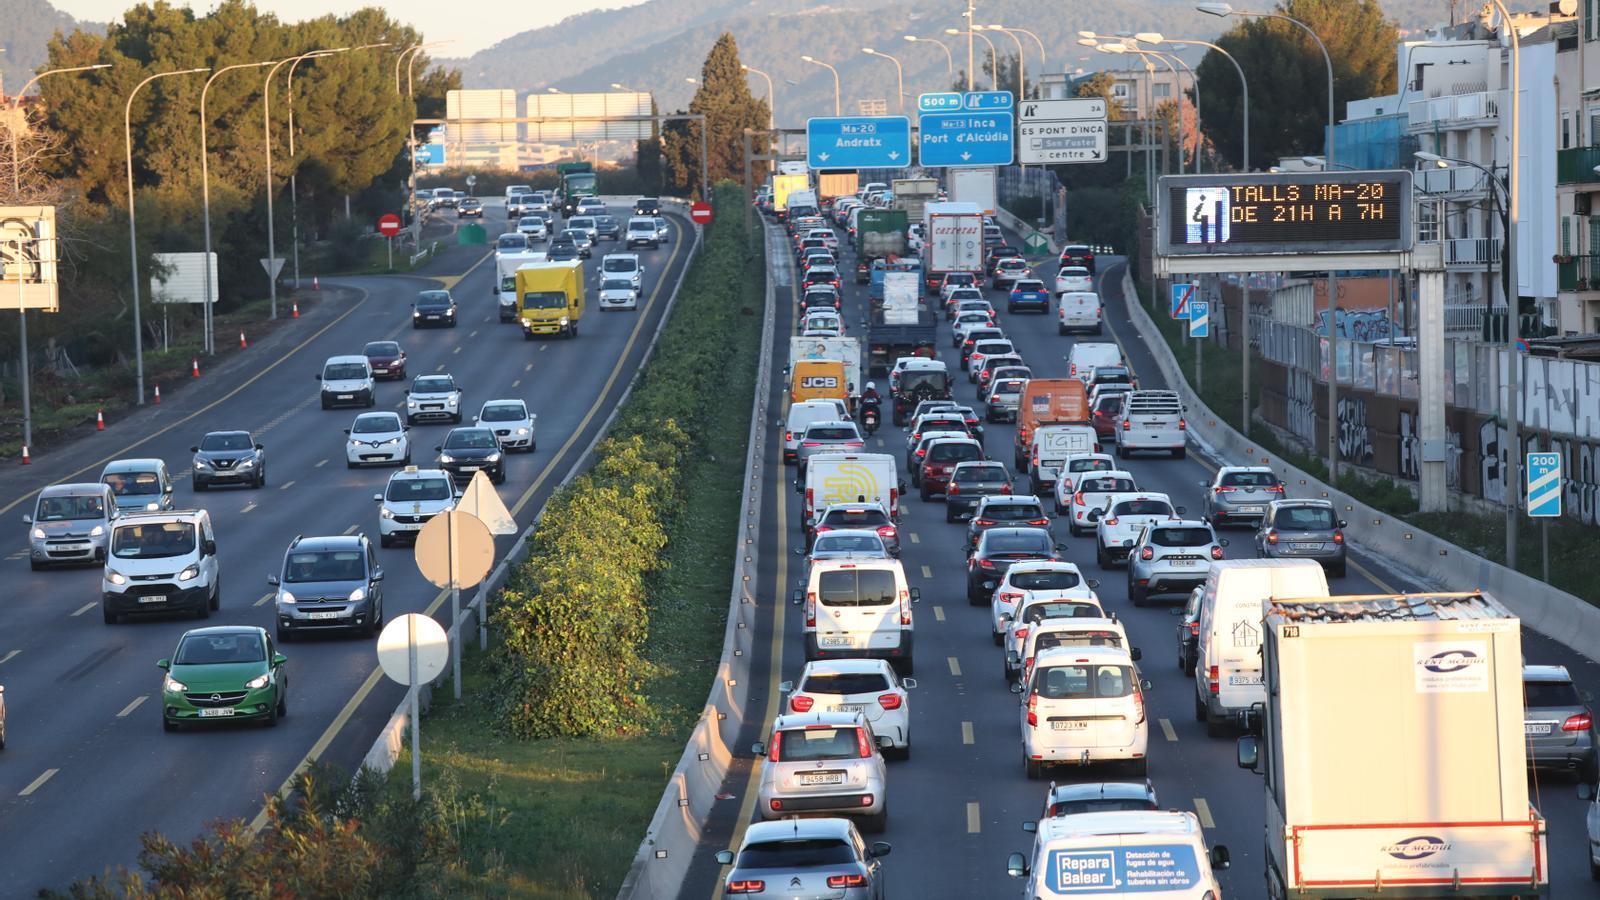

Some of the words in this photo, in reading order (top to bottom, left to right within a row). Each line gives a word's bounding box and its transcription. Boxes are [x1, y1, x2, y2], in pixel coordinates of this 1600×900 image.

[924, 98, 945, 106] 500
[969, 119, 996, 128] Inca
[842, 124, 876, 134] Ma-20
[1039, 126, 1067, 135] PONT
[1071, 125, 1104, 134] D'INCA
[836, 137, 882, 147] Andratx
[923, 133, 948, 143] Port
[956, 131, 1009, 143] d'Alcúdia
[1231, 185, 1300, 202] TALLS
[1315, 183, 1383, 200] MA-20
[1231, 206, 1258, 222] DE
[1273, 205, 1313, 222] 21H
[1329, 204, 1341, 220] A
[1357, 203, 1383, 220] 7H
[802, 377, 837, 388] JCB
[1532, 456, 1555, 466] 200
[806, 775, 824, 783] 9458
[1061, 857, 1110, 871] Repara
[1126, 859, 1146, 868] fugas
[1157, 860, 1175, 868] agua
[1062, 871, 1106, 884] Balear
[1176, 869, 1185, 877] de
